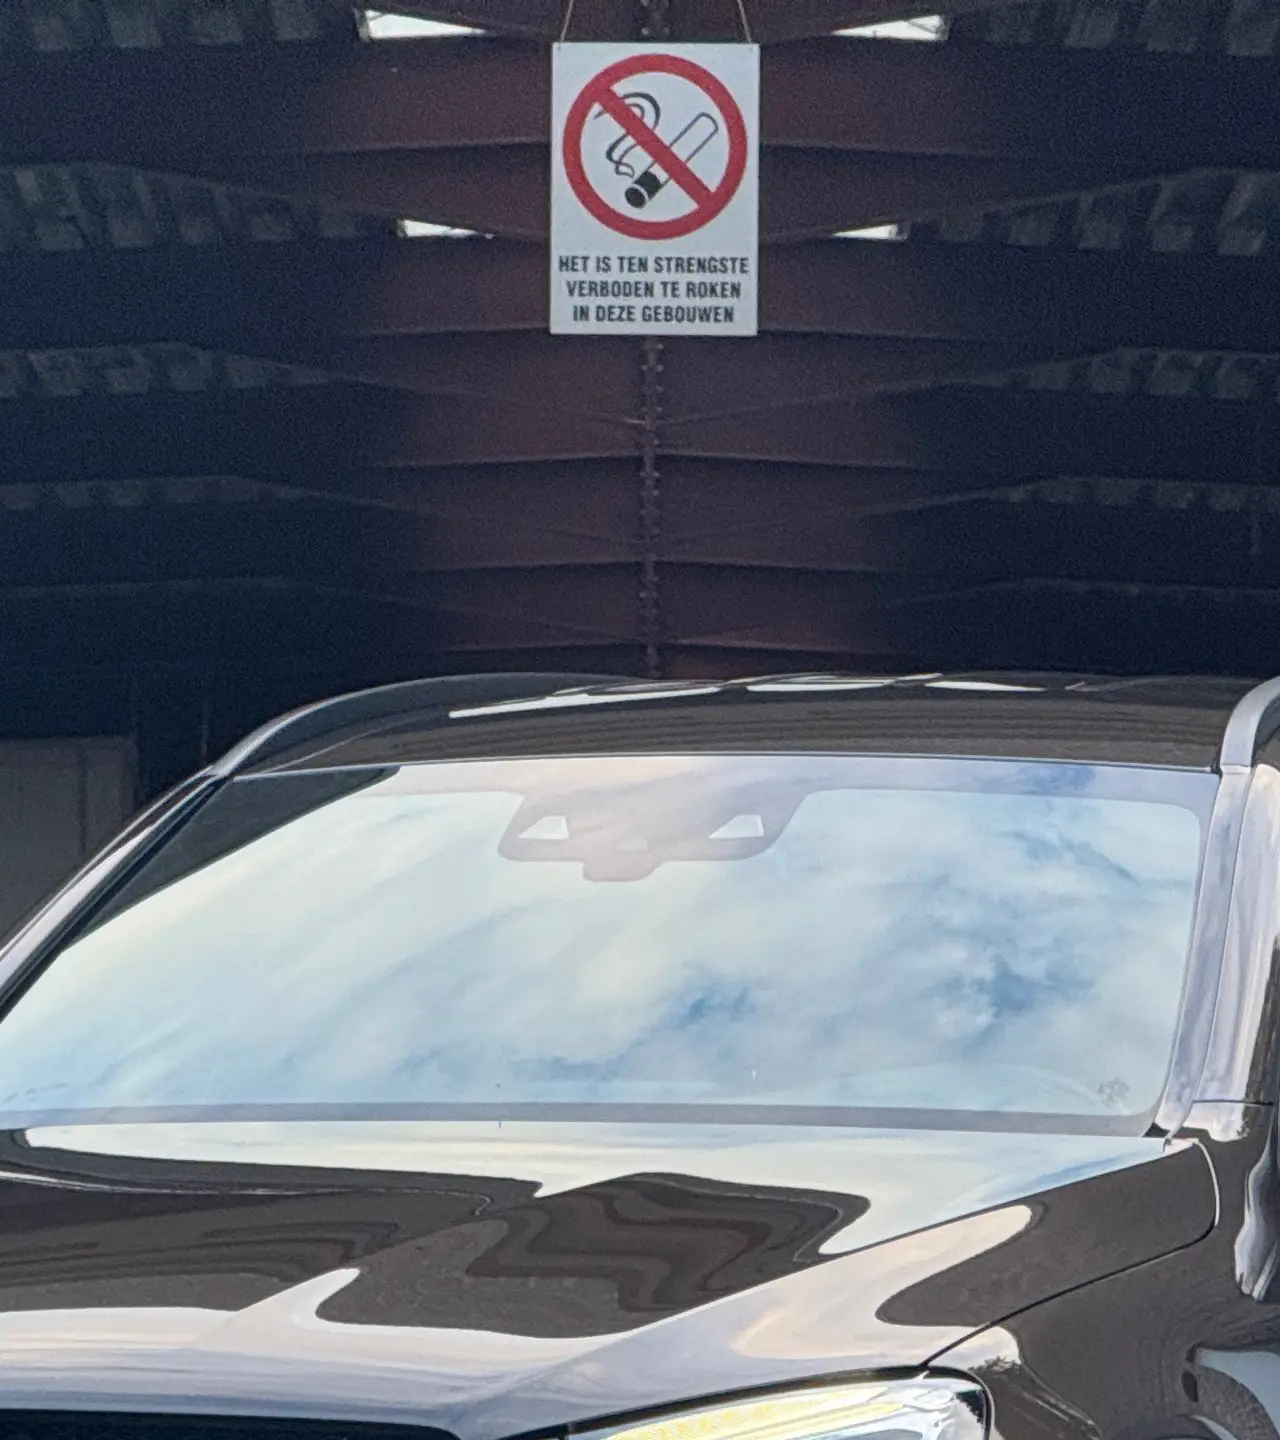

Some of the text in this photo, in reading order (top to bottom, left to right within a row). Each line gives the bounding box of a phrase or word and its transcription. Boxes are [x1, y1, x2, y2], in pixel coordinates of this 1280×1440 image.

[559, 256, 749, 273] HET IS TEN STRENGSTE
[567, 281, 741, 299] VERBODEN TE ROKEN
[573, 306, 734, 323] IN DEZE GEBOUWEN
